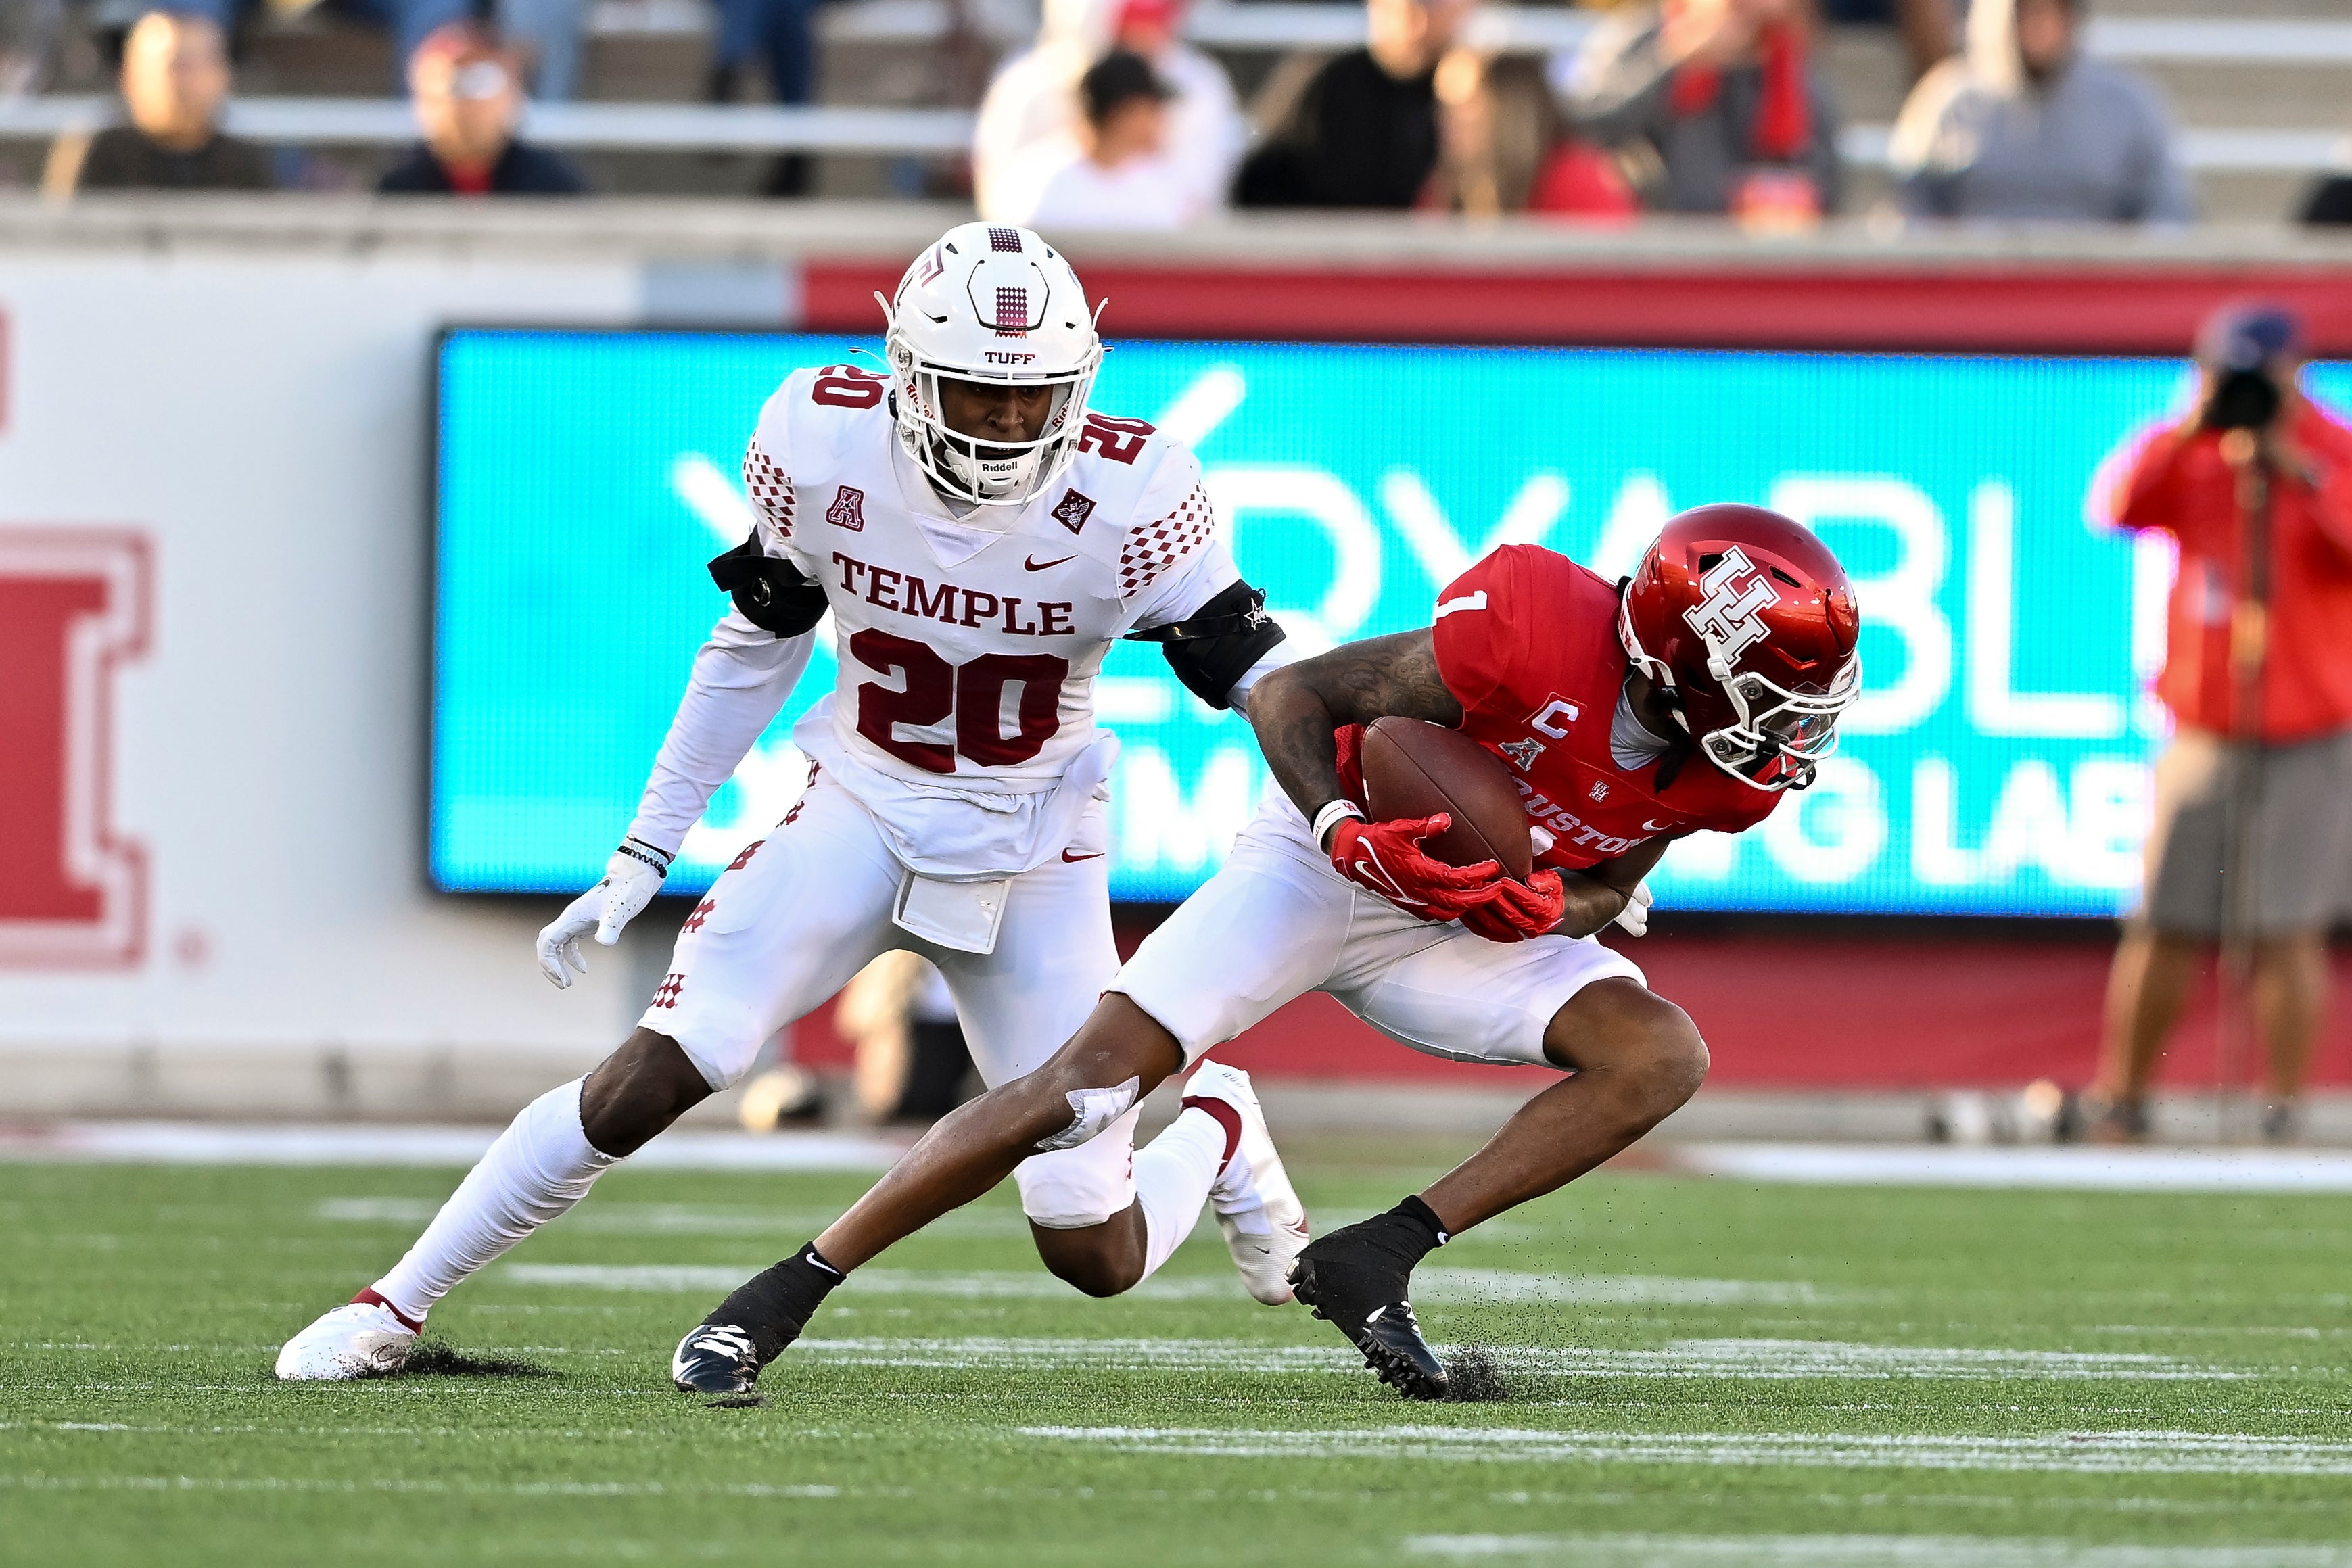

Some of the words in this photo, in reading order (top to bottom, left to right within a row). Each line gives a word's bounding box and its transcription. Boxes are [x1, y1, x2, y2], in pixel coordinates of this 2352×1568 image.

[985, 351, 1035, 365] TUFF
[1077, 412, 1157, 466] 20
[982, 461, 1018, 473] Riddell
[832, 551, 1075, 637] TEMPLE
[1432, 590, 1488, 628] 1
[849, 626, 1070, 774] 20
[1531, 698, 1580, 740] C
